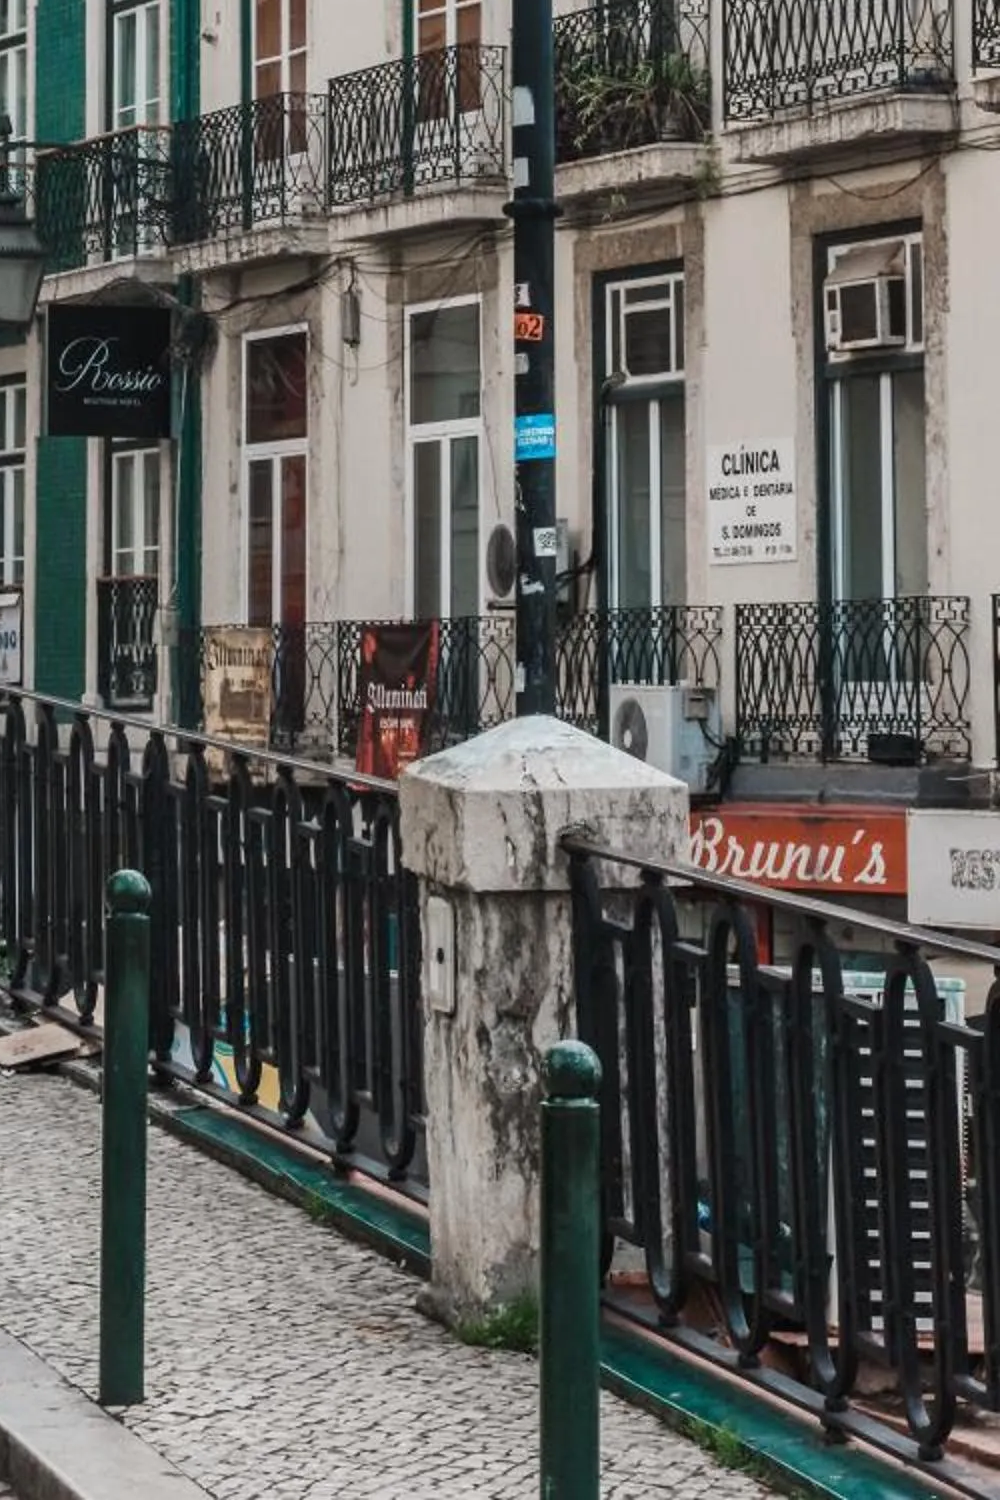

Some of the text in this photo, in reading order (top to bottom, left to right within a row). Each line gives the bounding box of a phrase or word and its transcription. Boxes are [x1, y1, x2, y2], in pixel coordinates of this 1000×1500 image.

[55, 336, 162, 391] Rossio
[721, 444, 780, 476] CLÍNICA
[732, 522, 782, 539] DOMINGOS
